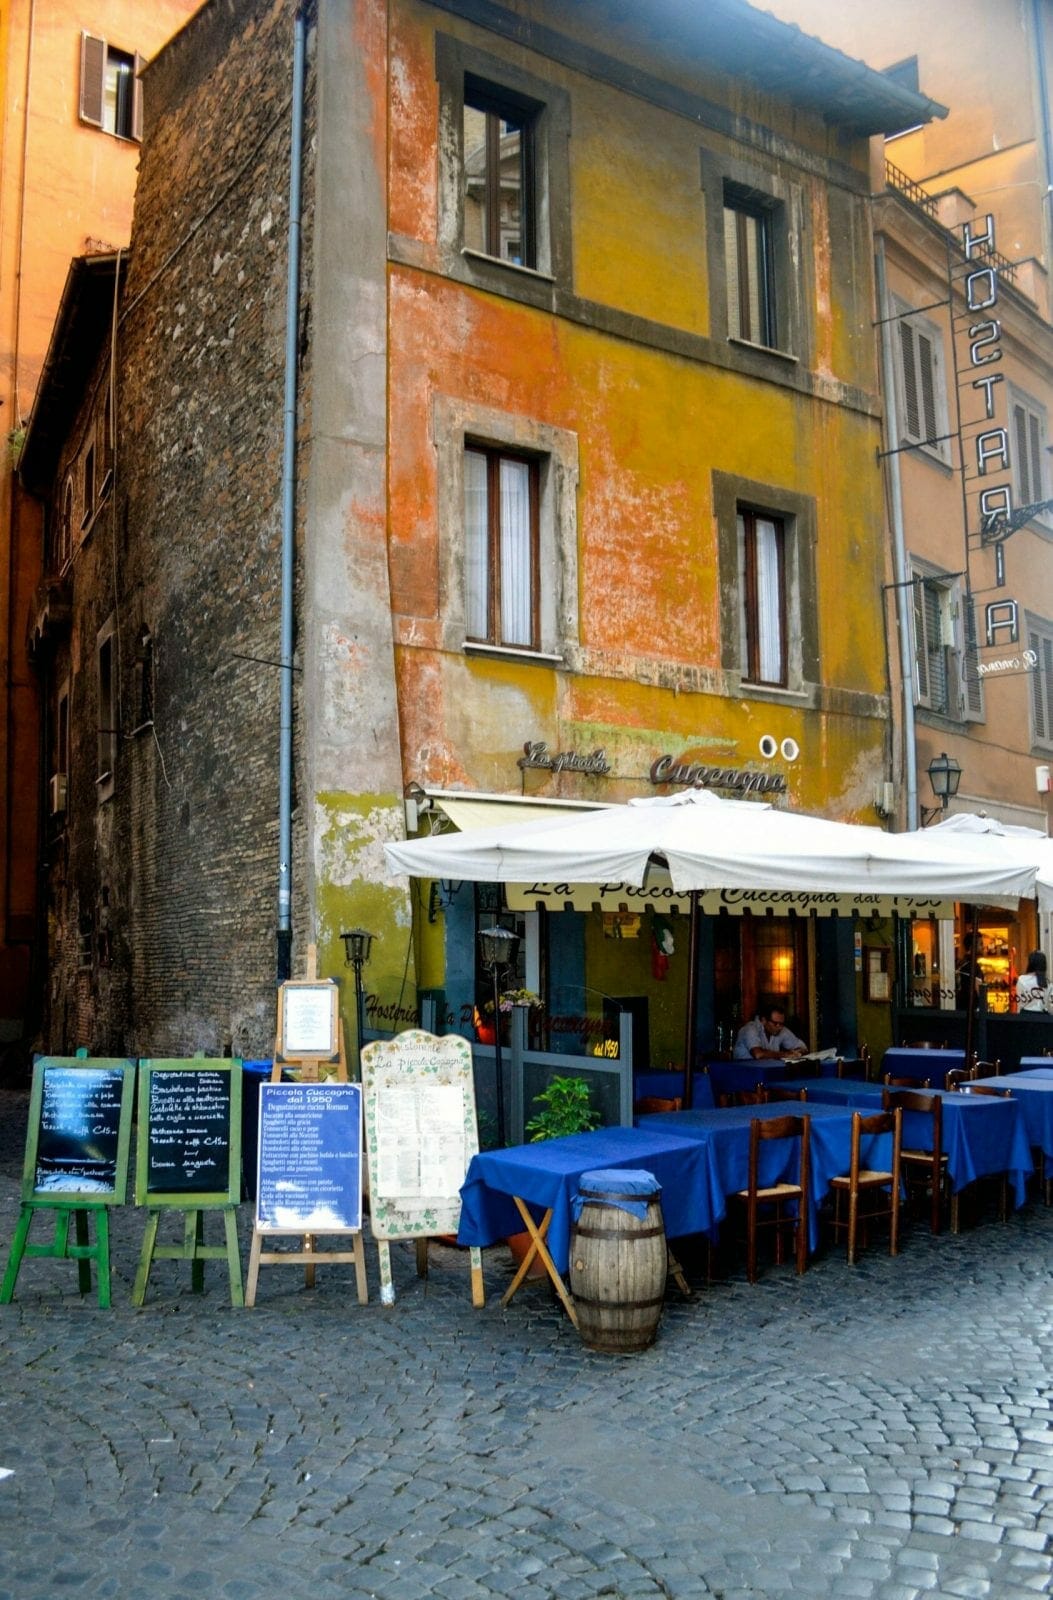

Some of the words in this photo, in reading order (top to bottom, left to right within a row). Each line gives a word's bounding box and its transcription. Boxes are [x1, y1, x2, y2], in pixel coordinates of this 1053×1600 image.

[651, 755, 788, 797] Cuccagna
[600, 882, 705, 898] Picco
[720, 888, 842, 906] Cuccagna
[365, 994, 420, 1025] Hosteria
[266, 1088, 303, 1096] Piccola
[305, 1088, 354, 1098] Cuccagna
[306, 1096, 332, 1104] 1950
